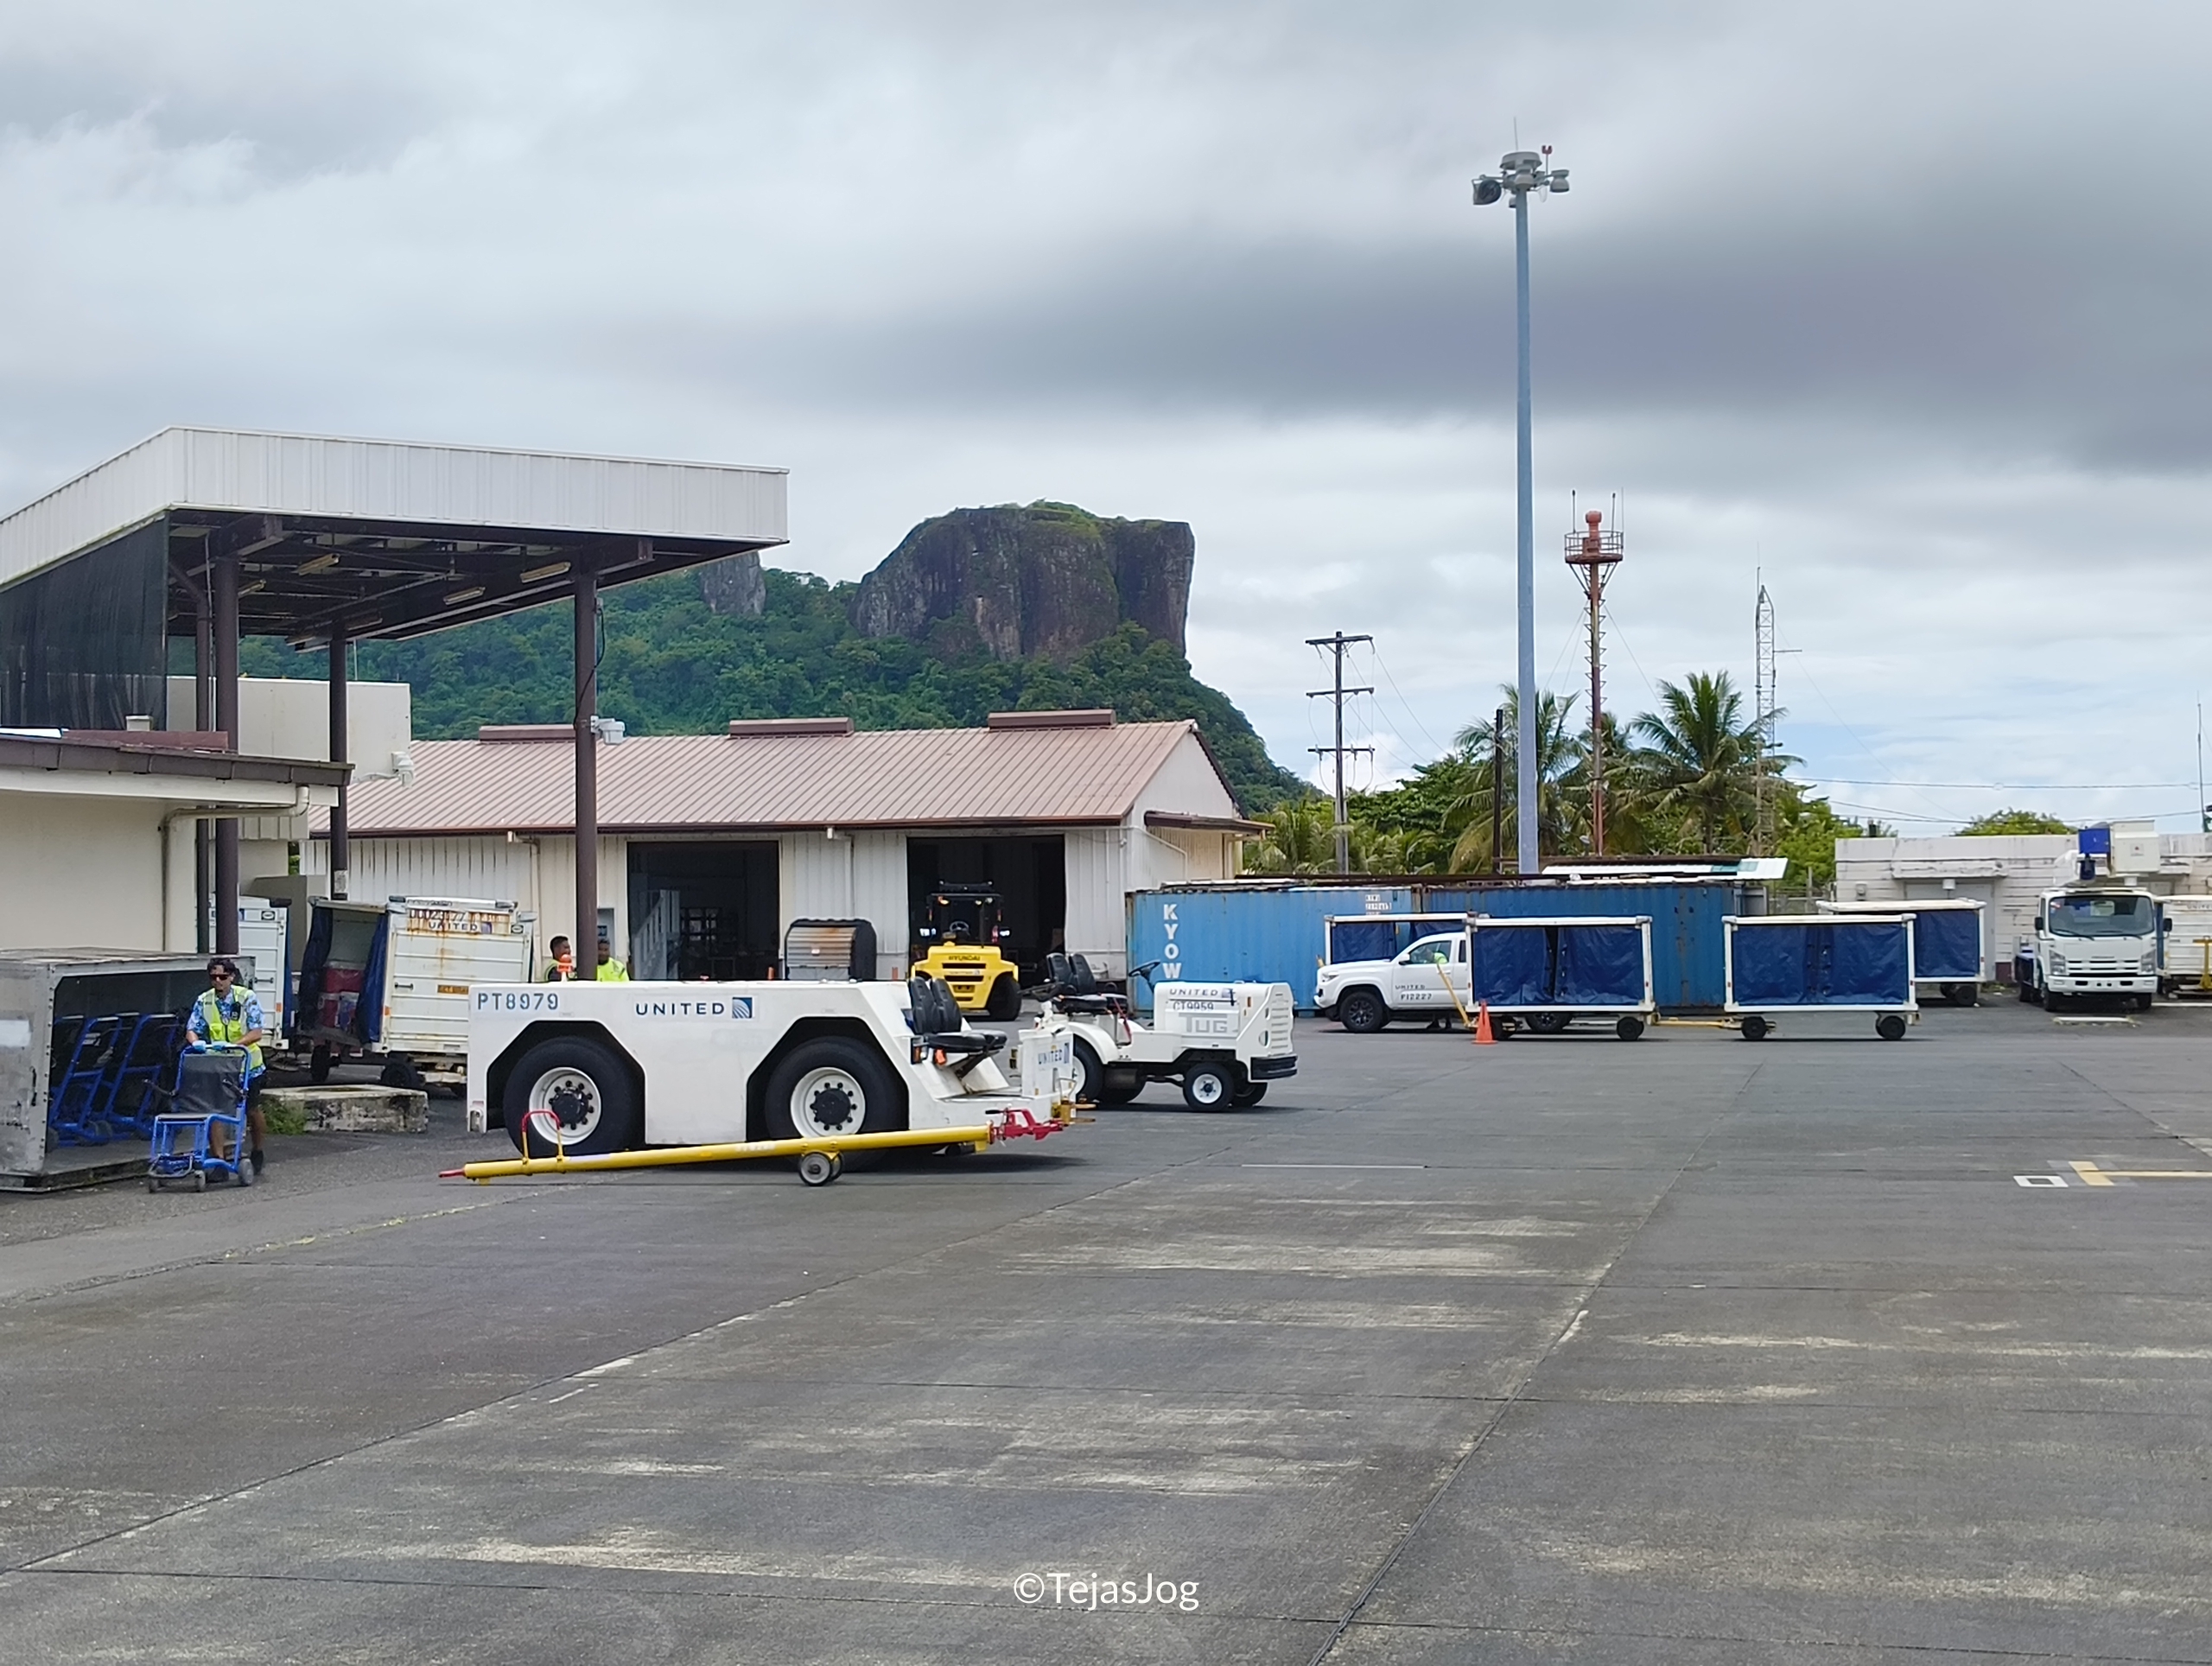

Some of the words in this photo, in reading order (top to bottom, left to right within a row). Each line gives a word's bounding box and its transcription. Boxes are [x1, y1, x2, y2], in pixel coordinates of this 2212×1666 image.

[429, 921, 478, 932] UNITED
[1163, 904, 1181, 978] KYOW
[477, 993, 559, 1010] PT8979
[636, 1002, 725, 1015] UNITED
[1179, 1013, 1228, 1033] TUG
[1038, 1049, 1063, 1065] UNITED
